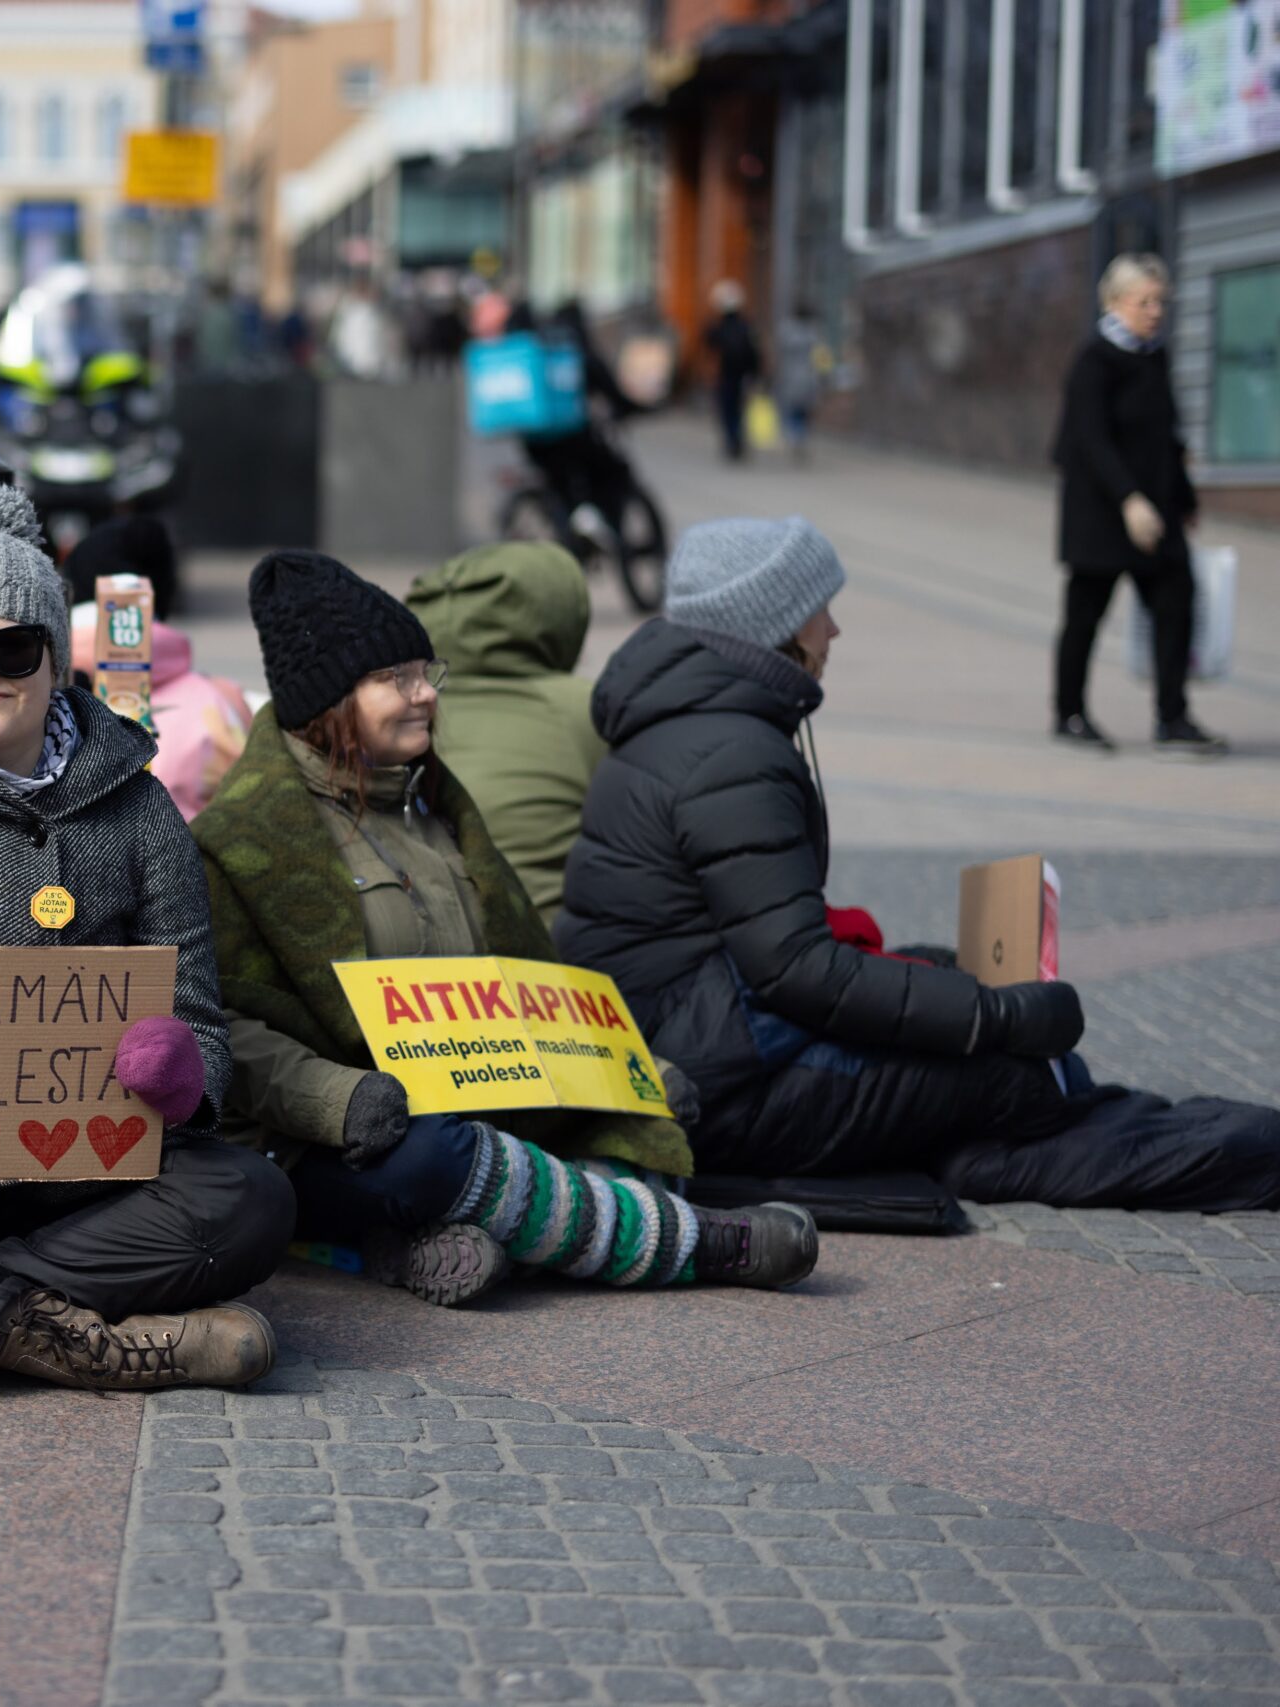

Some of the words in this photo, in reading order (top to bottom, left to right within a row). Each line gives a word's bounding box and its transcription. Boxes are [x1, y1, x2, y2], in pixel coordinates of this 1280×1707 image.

[376, 977, 629, 1033] ÄITIKAPINA
[385, 1037, 527, 1061] elinkelpoisen
[534, 1037, 614, 1061] maailman
[450, 1061, 542, 1089] puolesta
